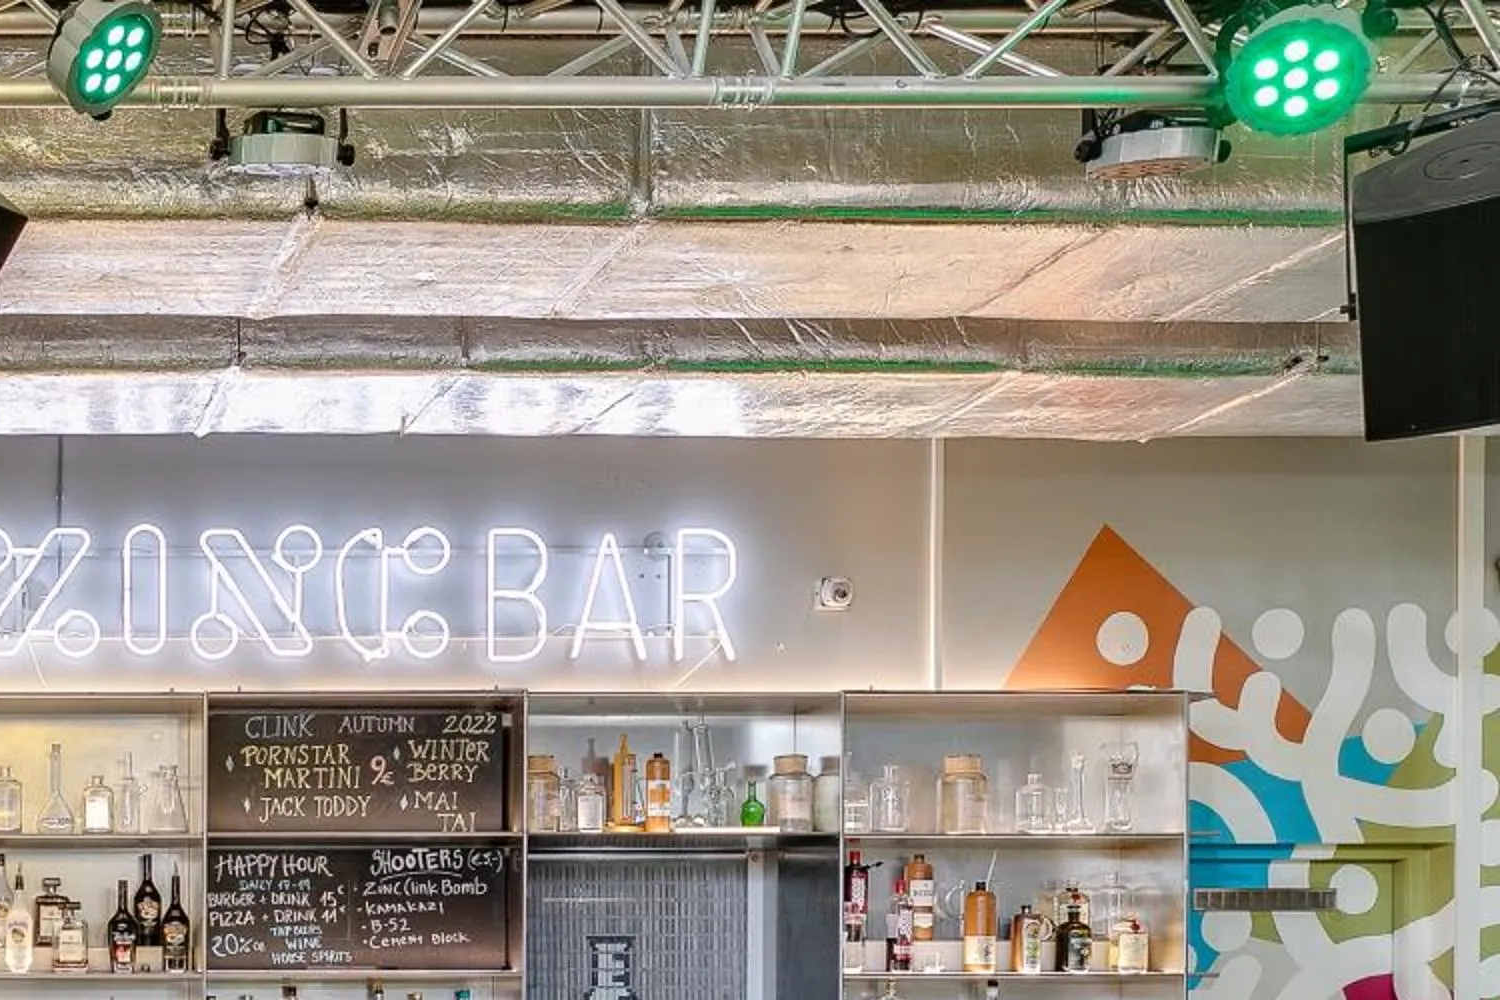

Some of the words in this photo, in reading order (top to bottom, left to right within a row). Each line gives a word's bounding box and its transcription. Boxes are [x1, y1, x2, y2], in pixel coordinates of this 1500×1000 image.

[486, 526, 738, 662] BAR
[245, 715, 315, 739] CLINK
[338, 715, 415, 734] AUTUMN
[442, 712, 496, 734] 2022
[240, 743, 351, 767] PORNSTAR
[264, 767, 360, 789] MARTINI
[259, 796, 306, 823] JACK
[313, 795, 371, 818] TODDY
[413, 791, 458, 811] MAI
[214, 853, 279, 882] HAPPY
[281, 854, 333, 877] HOUR
[370, 848, 463, 877] SHOOTERS
[441, 876, 488, 896] Bomb
[207, 891, 256, 908] BURGER
[271, 891, 311, 907] DRINK
[365, 901, 445, 917] KAMAKAZI
[209, 909, 256, 927] PIZZA
[273, 908, 317, 923] DRINK
[370, 918, 411, 934] B-52
[285, 936, 322, 950] WINE
[271, 951, 307, 965] HOUSE
